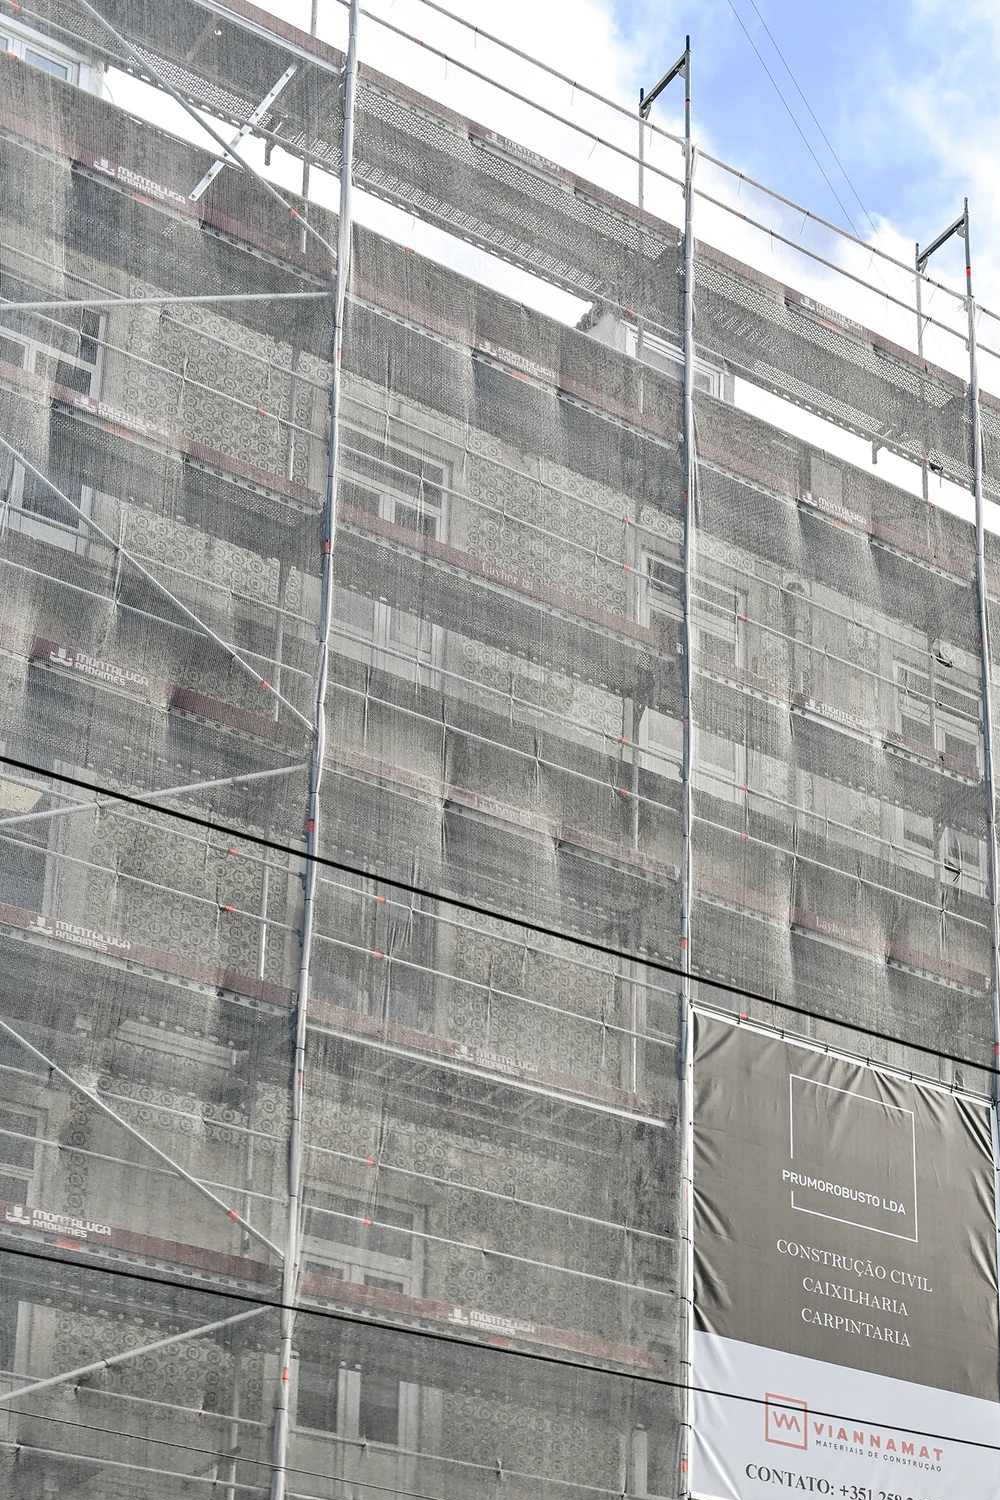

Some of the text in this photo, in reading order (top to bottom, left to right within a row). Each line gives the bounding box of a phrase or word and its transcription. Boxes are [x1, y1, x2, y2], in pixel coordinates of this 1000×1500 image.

[117, 165, 186, 205] MONTALUGA
[76, 652, 149, 688] MONTALUGA
[56, 920, 131, 950] MONTALUGA
[782, 1169, 906, 1215] PRUMOROBUSTO LDA
[32, 1209, 112, 1236] MONTALUGA
[32, 1219, 88, 1239] ANDAIMES
[776, 1239, 933, 1293] CONSTRUÇÃO CIVIL
[802, 1277, 909, 1316] CAIXILHARIA
[801, 1307, 911, 1347] CARPINTARIA
[813, 1421, 943, 1461] VIANNAMAT
[815, 1439, 942, 1473] MATERIAIS DE CONSTRUÇÃO
[745, 1463, 835, 1496] CONTATO:
